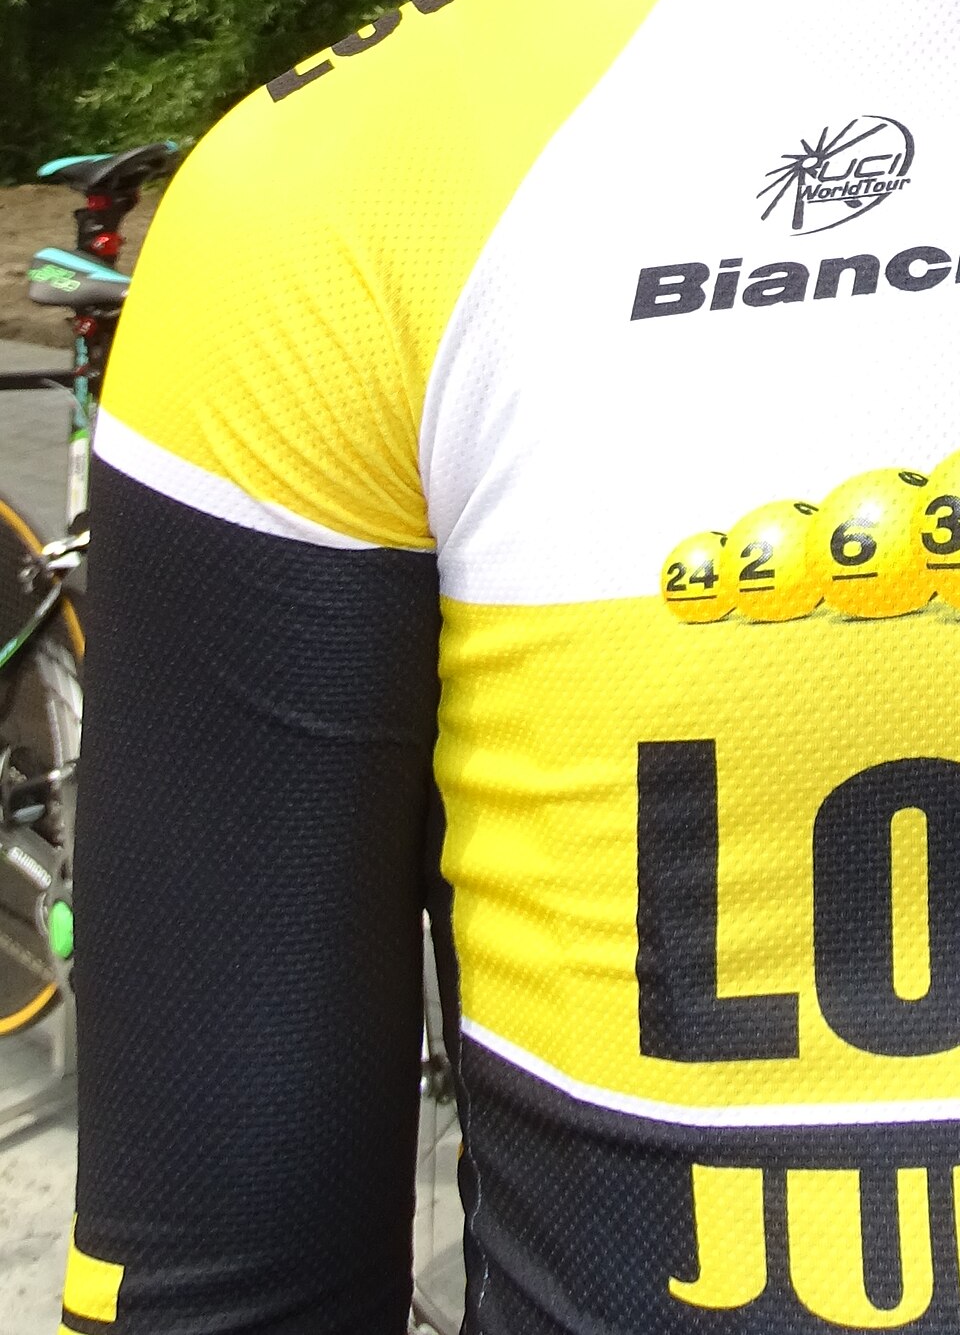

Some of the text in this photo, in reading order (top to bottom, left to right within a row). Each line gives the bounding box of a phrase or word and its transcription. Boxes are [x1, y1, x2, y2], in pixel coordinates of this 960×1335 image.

[817, 152, 903, 183] UCI
[801, 178, 912, 201] WorldTour
[830, 517, 878, 567] 6
[666, 559, 720, 593] 24
[739, 540, 776, 582] 2
